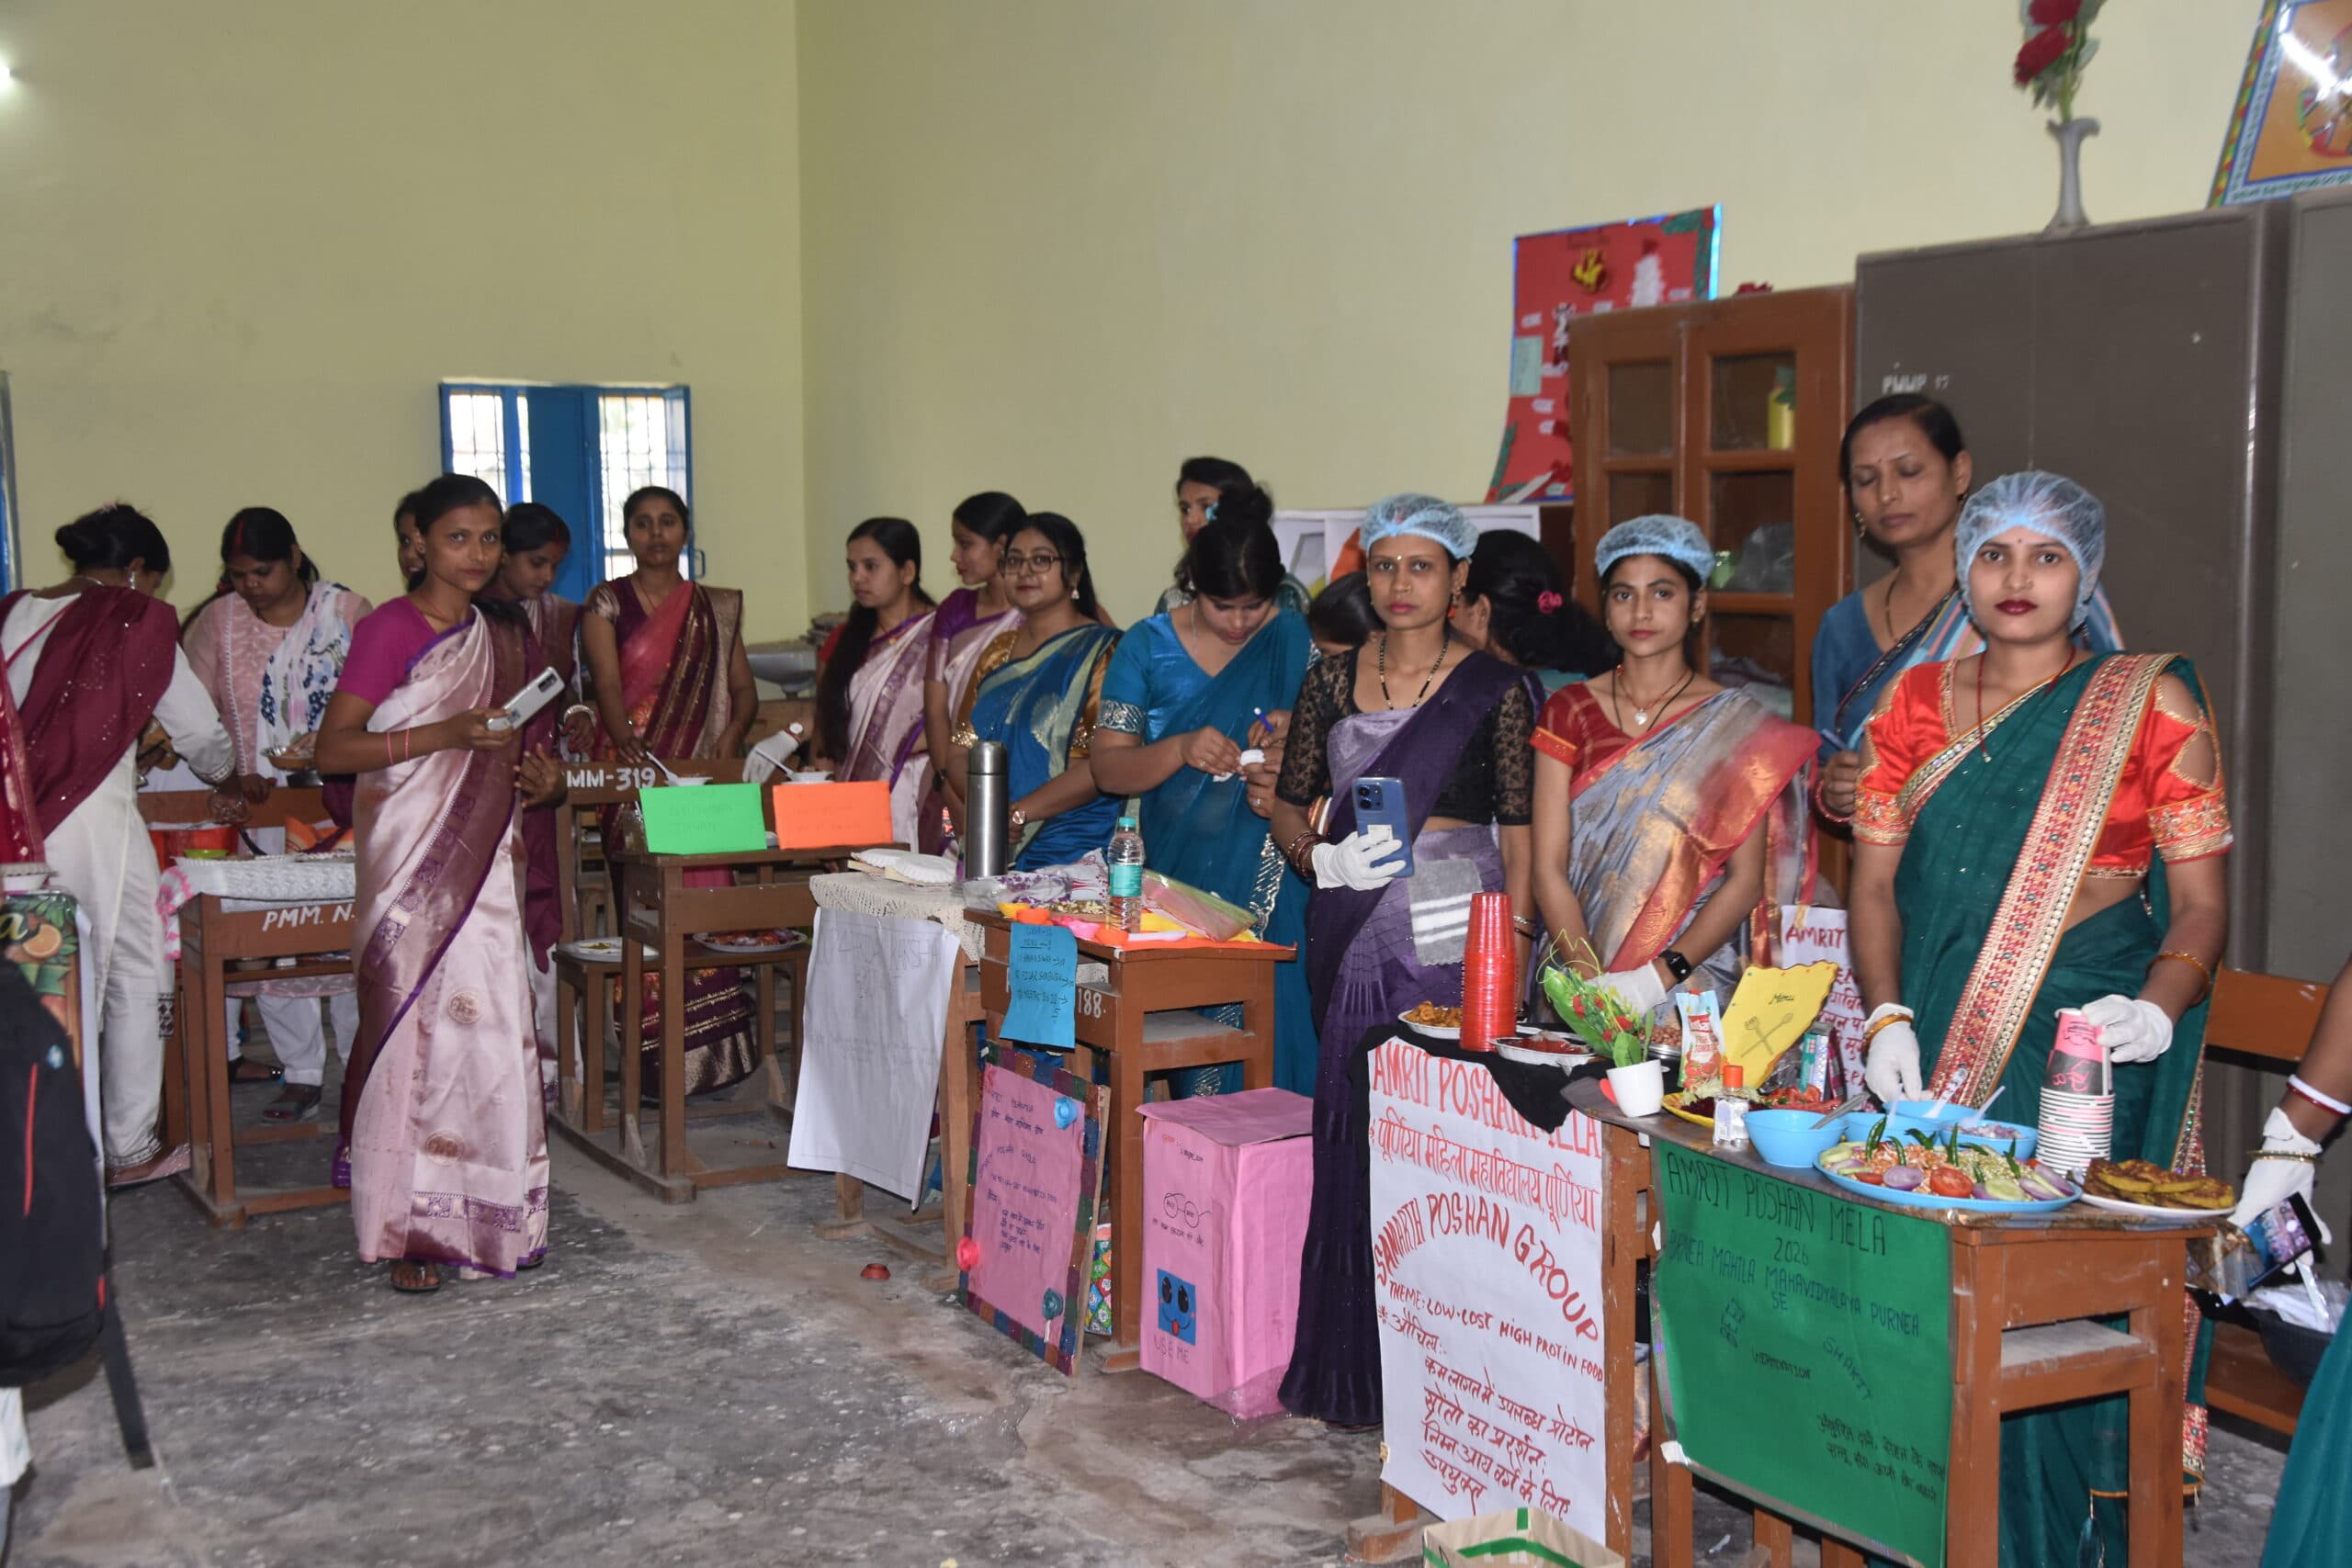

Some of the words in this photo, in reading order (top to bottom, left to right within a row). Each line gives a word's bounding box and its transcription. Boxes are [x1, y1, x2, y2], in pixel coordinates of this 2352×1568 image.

[561, 767, 656, 791] MM-319
[262, 906, 324, 931] PMM.
[1786, 925, 1846, 949] AMRIT
[1373, 1042, 1433, 1108] AMRIT
[1425, 1123, 1470, 1188] महिला
[1667, 1151, 1730, 1212] AMRIT
[1829, 1200, 1887, 1257] MELA
[1773, 1236, 1809, 1267] 2026
[1374, 1198, 1426, 1287] SAMARTH
[1426, 1192, 1510, 1250] POSHAN
[1514, 1224, 1600, 1342] GROUP
[1711, 1245, 1756, 1284] MAHILA
[1870, 1302, 1920, 1338] PURNEA
[1770, 1291, 1789, 1311] SE
[1153, 1335, 1174, 1360] USE
[1176, 1345, 1191, 1365] ME
[1425, 1355, 1449, 1382] कम
[1580, 1359, 1604, 1382] FOOD
[1467, 1412, 1490, 1440] का
[1421, 1419, 1459, 1455] निम्न
[1457, 1443, 1495, 1478] आय
[1519, 1470, 1538, 1506] के
[1540, 1478, 1571, 1522] लिए
